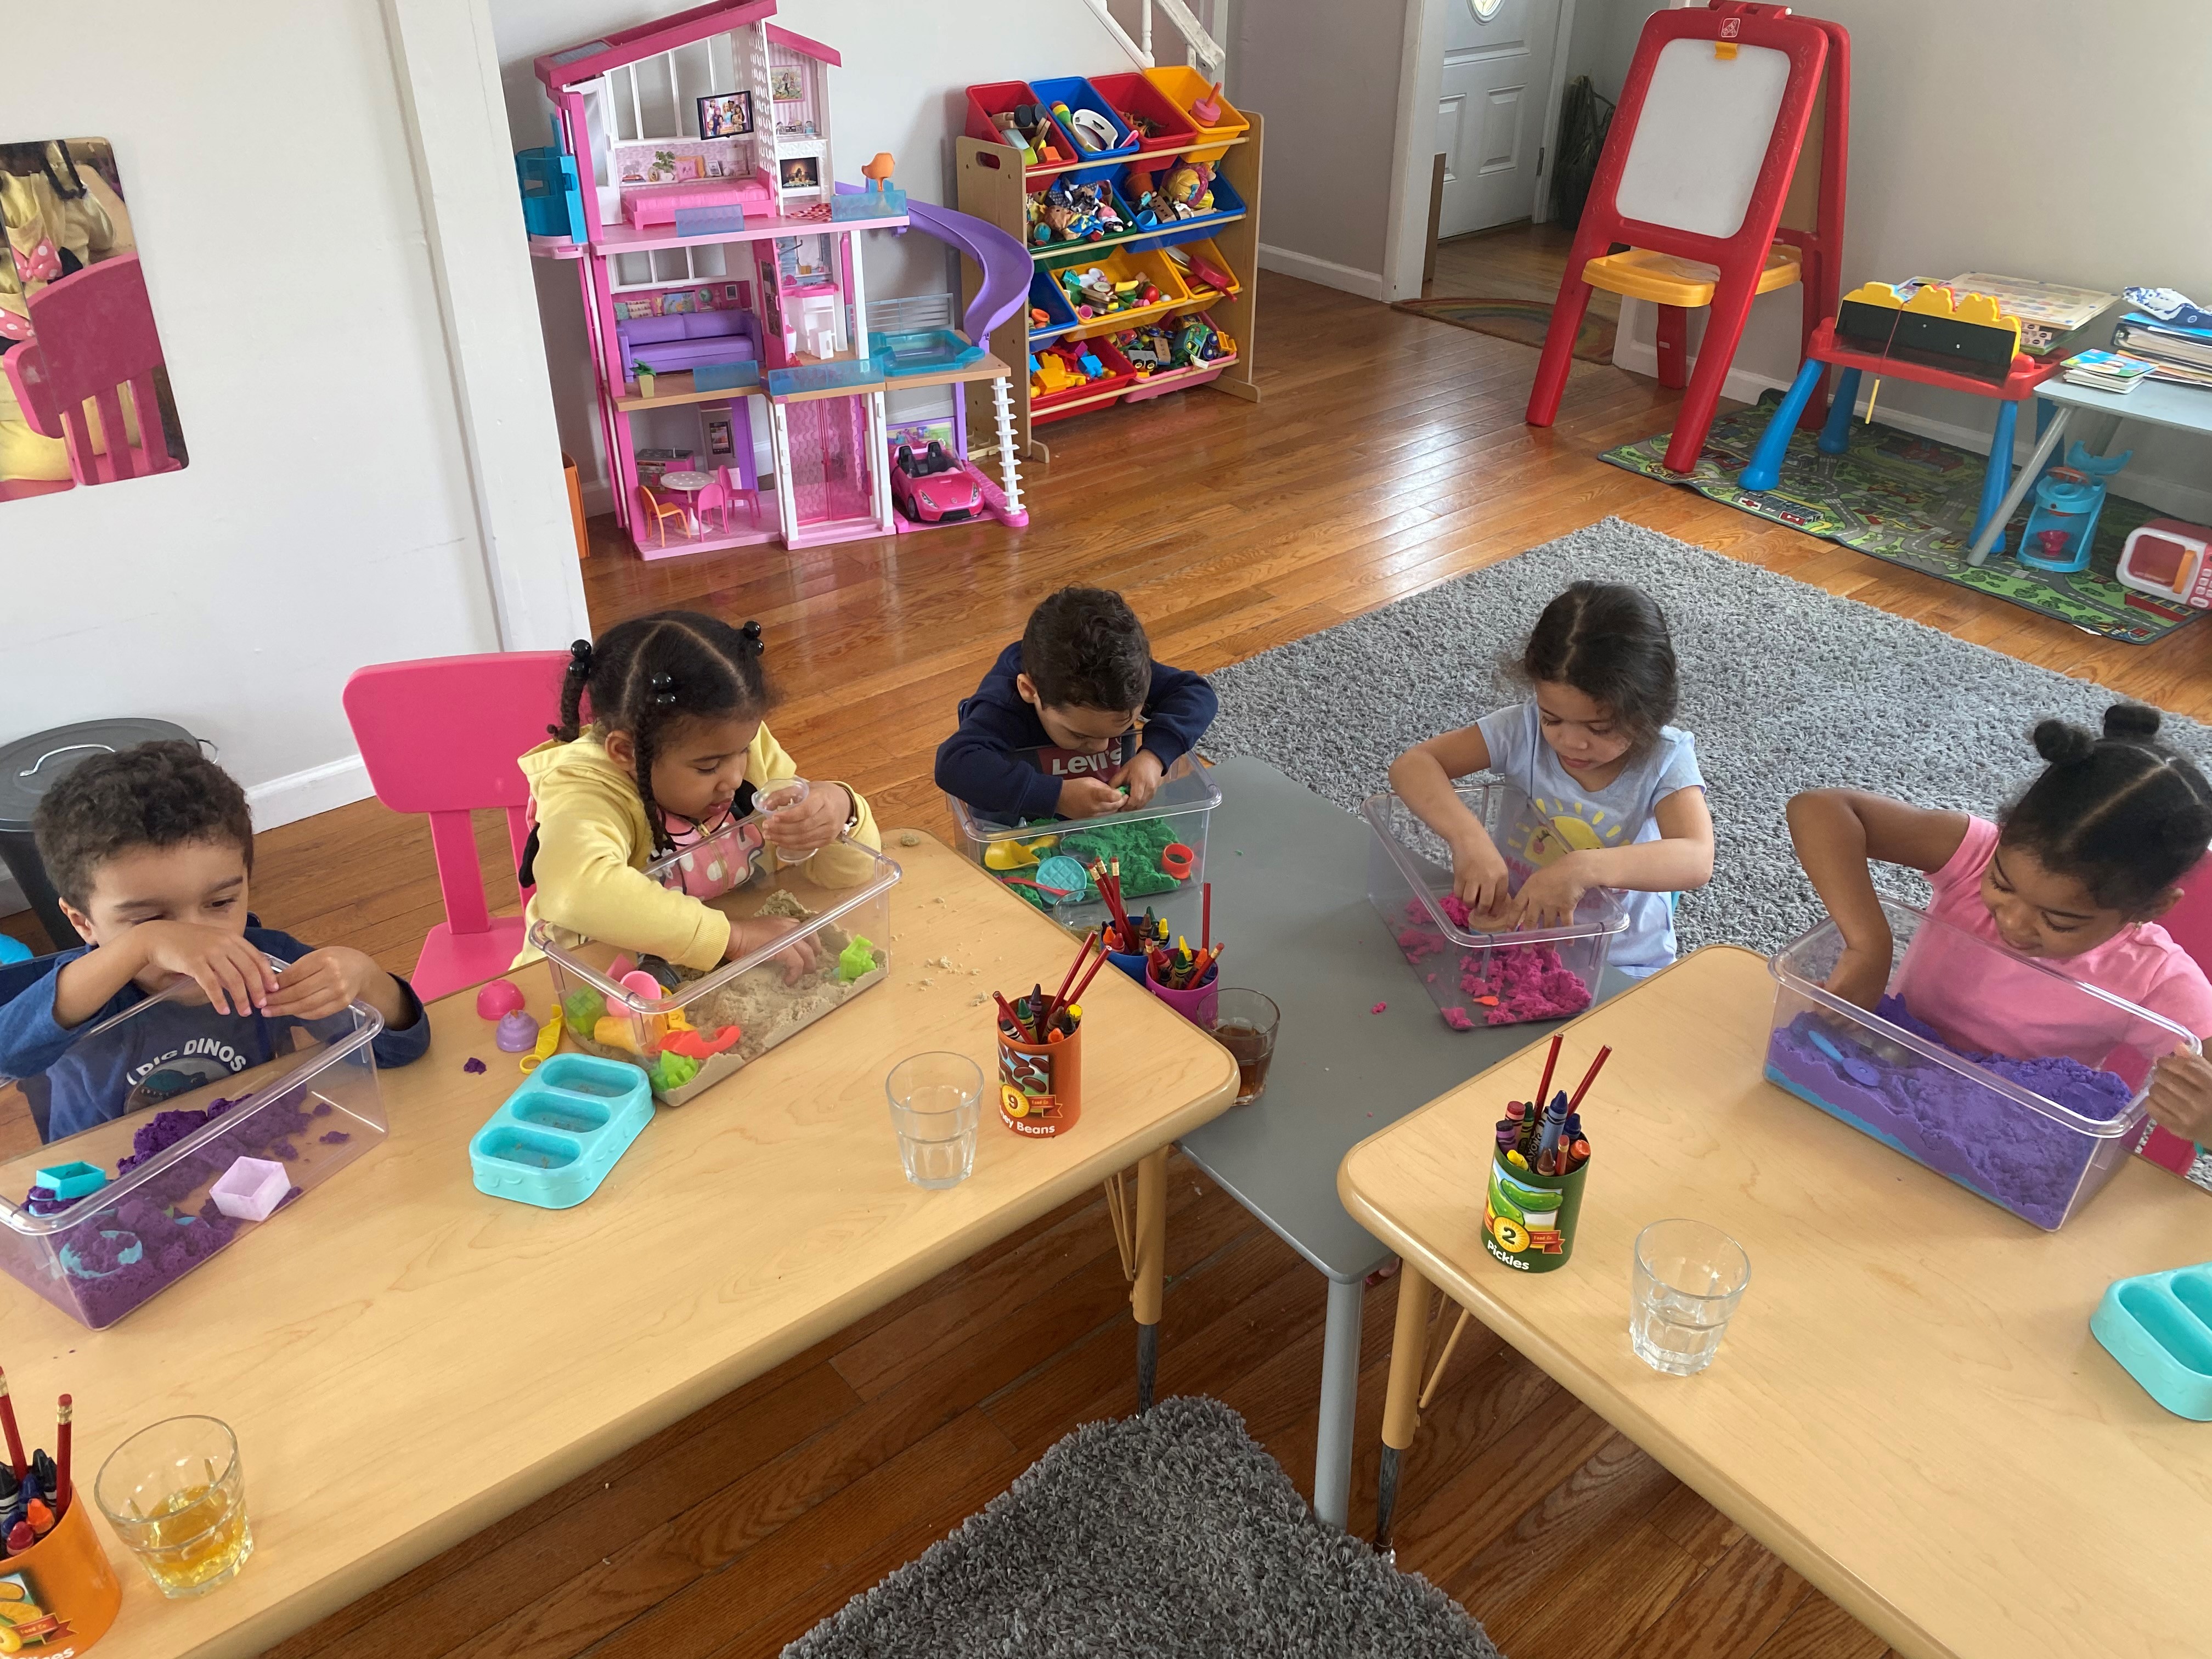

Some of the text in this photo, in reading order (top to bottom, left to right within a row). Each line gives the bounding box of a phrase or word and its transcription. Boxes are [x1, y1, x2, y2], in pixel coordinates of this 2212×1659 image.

[136, 1050, 178, 1076] DIG
[183, 1038, 246, 1071] DINOS
[1008, 1093, 1018, 1109] 9
[1017, 1121, 1055, 1135] Beans
[1502, 1226, 1516, 1245] 2
[1487, 1239, 1530, 1271] Pickles
